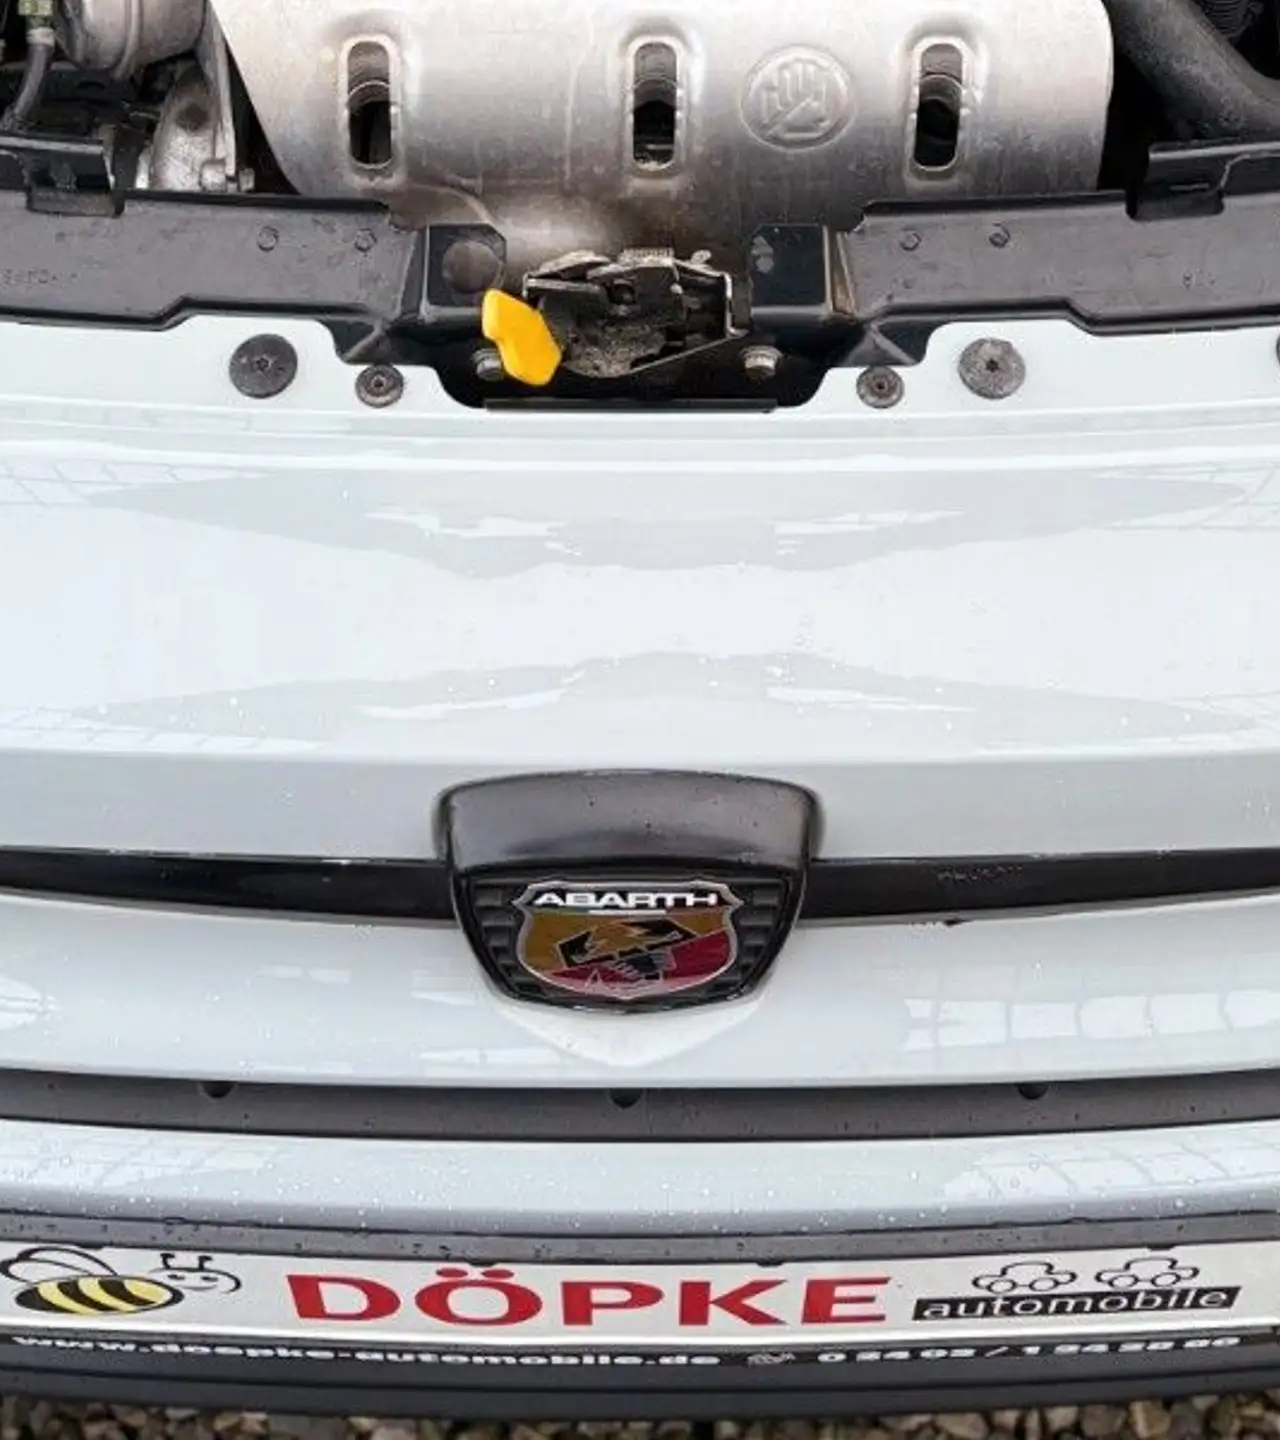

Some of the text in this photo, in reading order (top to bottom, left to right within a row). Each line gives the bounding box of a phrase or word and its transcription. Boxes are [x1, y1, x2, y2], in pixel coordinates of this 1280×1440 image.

[532, 892, 718, 908] ABARTH
[287, 1268, 891, 1326] DÖPKE
[921, 1288, 1228, 1318] automobile
[12, 1336, 720, 1365] www.doepke-automobile.de
